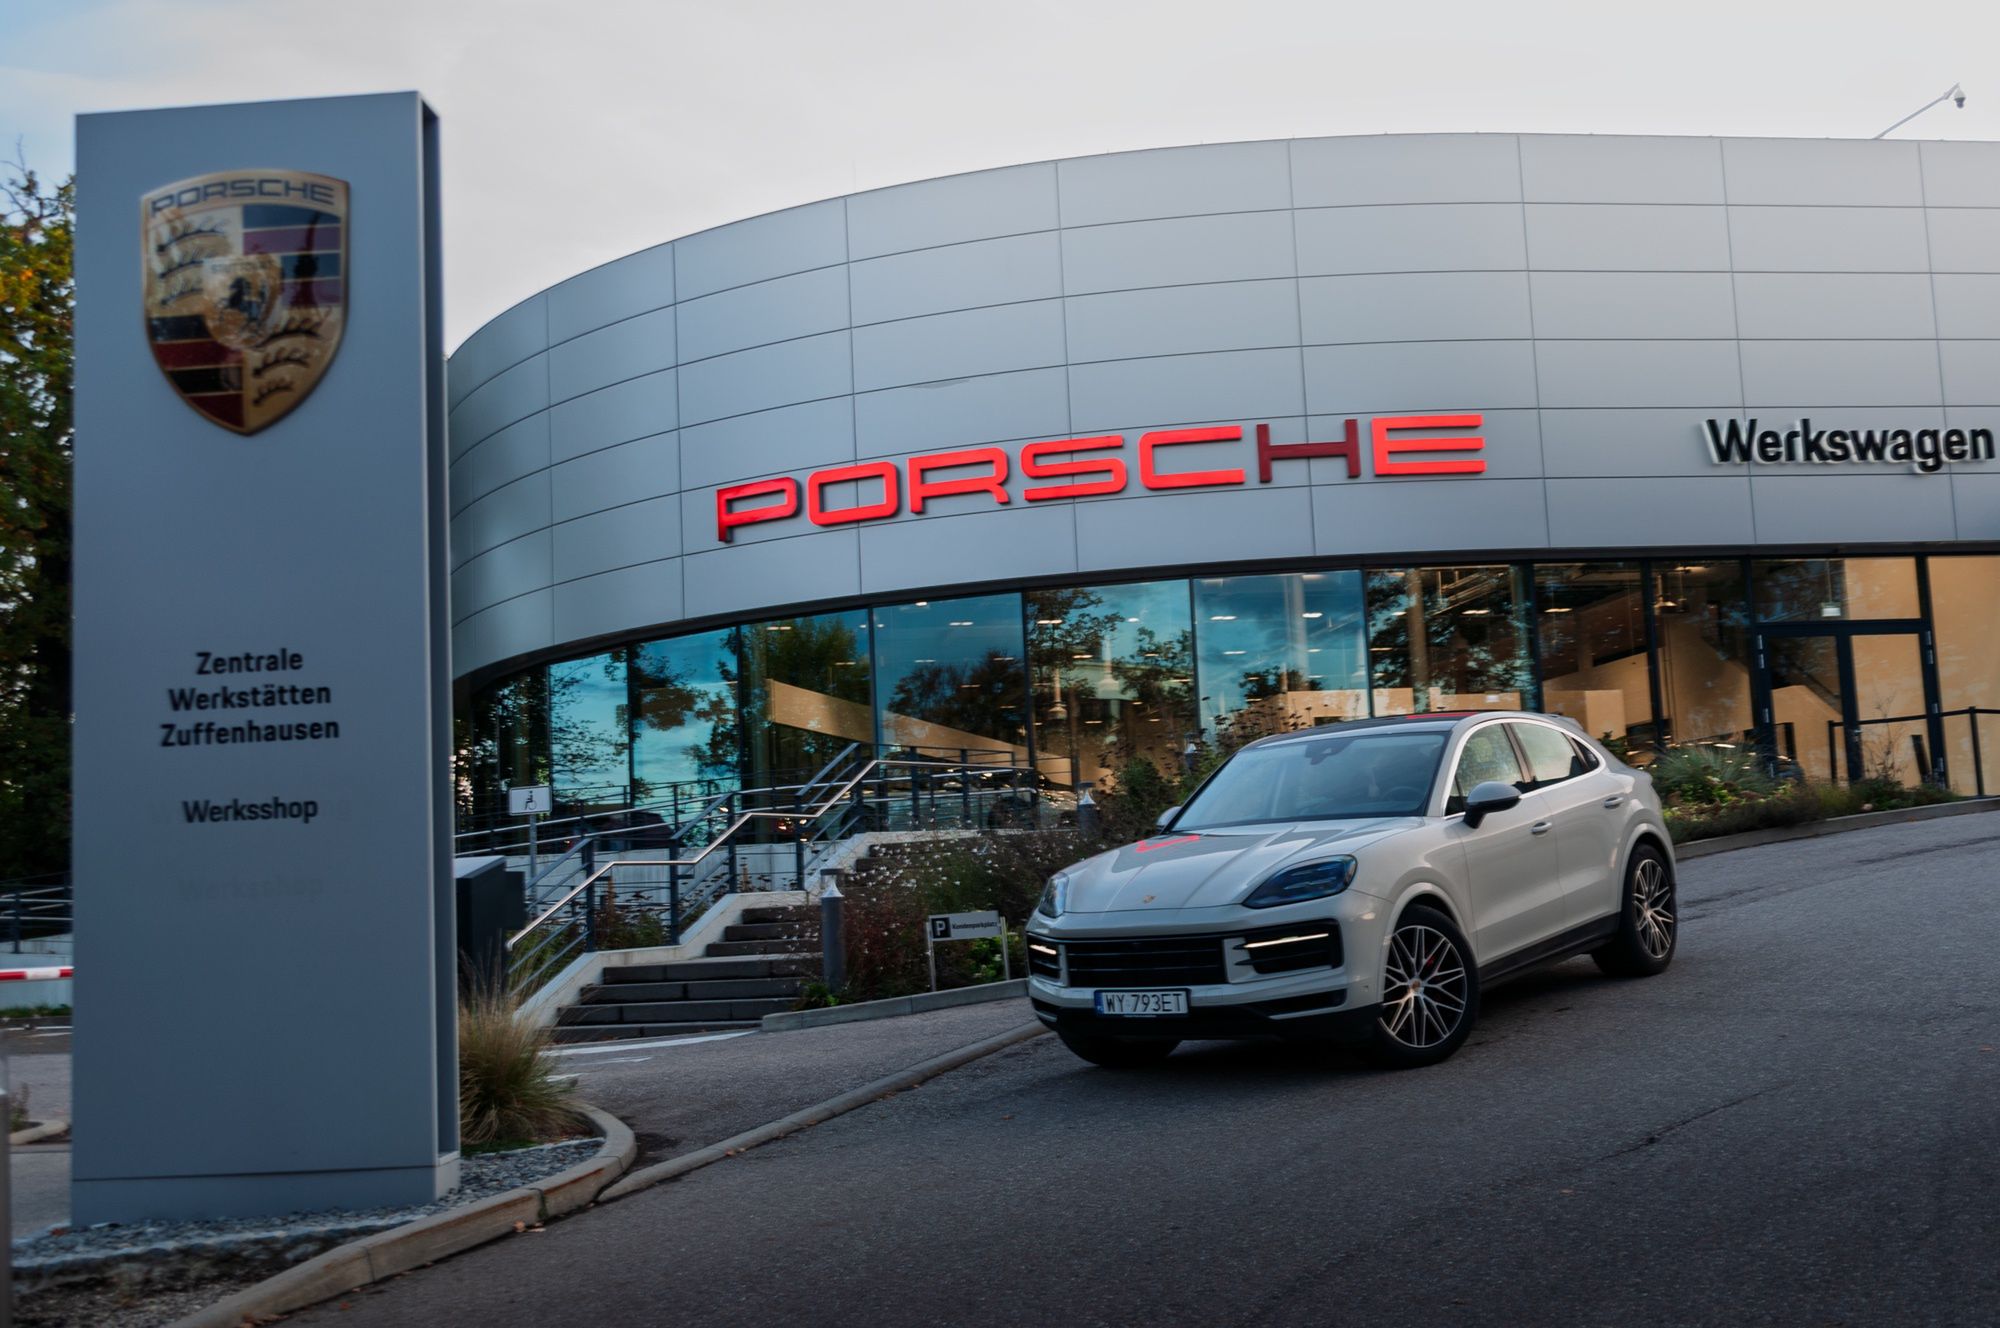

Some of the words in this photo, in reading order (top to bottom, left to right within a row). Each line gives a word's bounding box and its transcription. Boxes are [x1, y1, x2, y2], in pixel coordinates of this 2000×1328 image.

[151, 179, 335, 217] PORSCHE
[1705, 417, 1996, 473] Werkswagen
[717, 414, 1486, 542] PORSCHE
[196, 648, 303, 675] Zentrale
[168, 684, 333, 711] Werkstätten
[160, 719, 340, 747] Zuffenhausen
[183, 797, 318, 824] Werksshop
[935, 920, 946, 936] P
[1105, 993, 1125, 1012] WY
[1131, 993, 1183, 1012] 793ET
